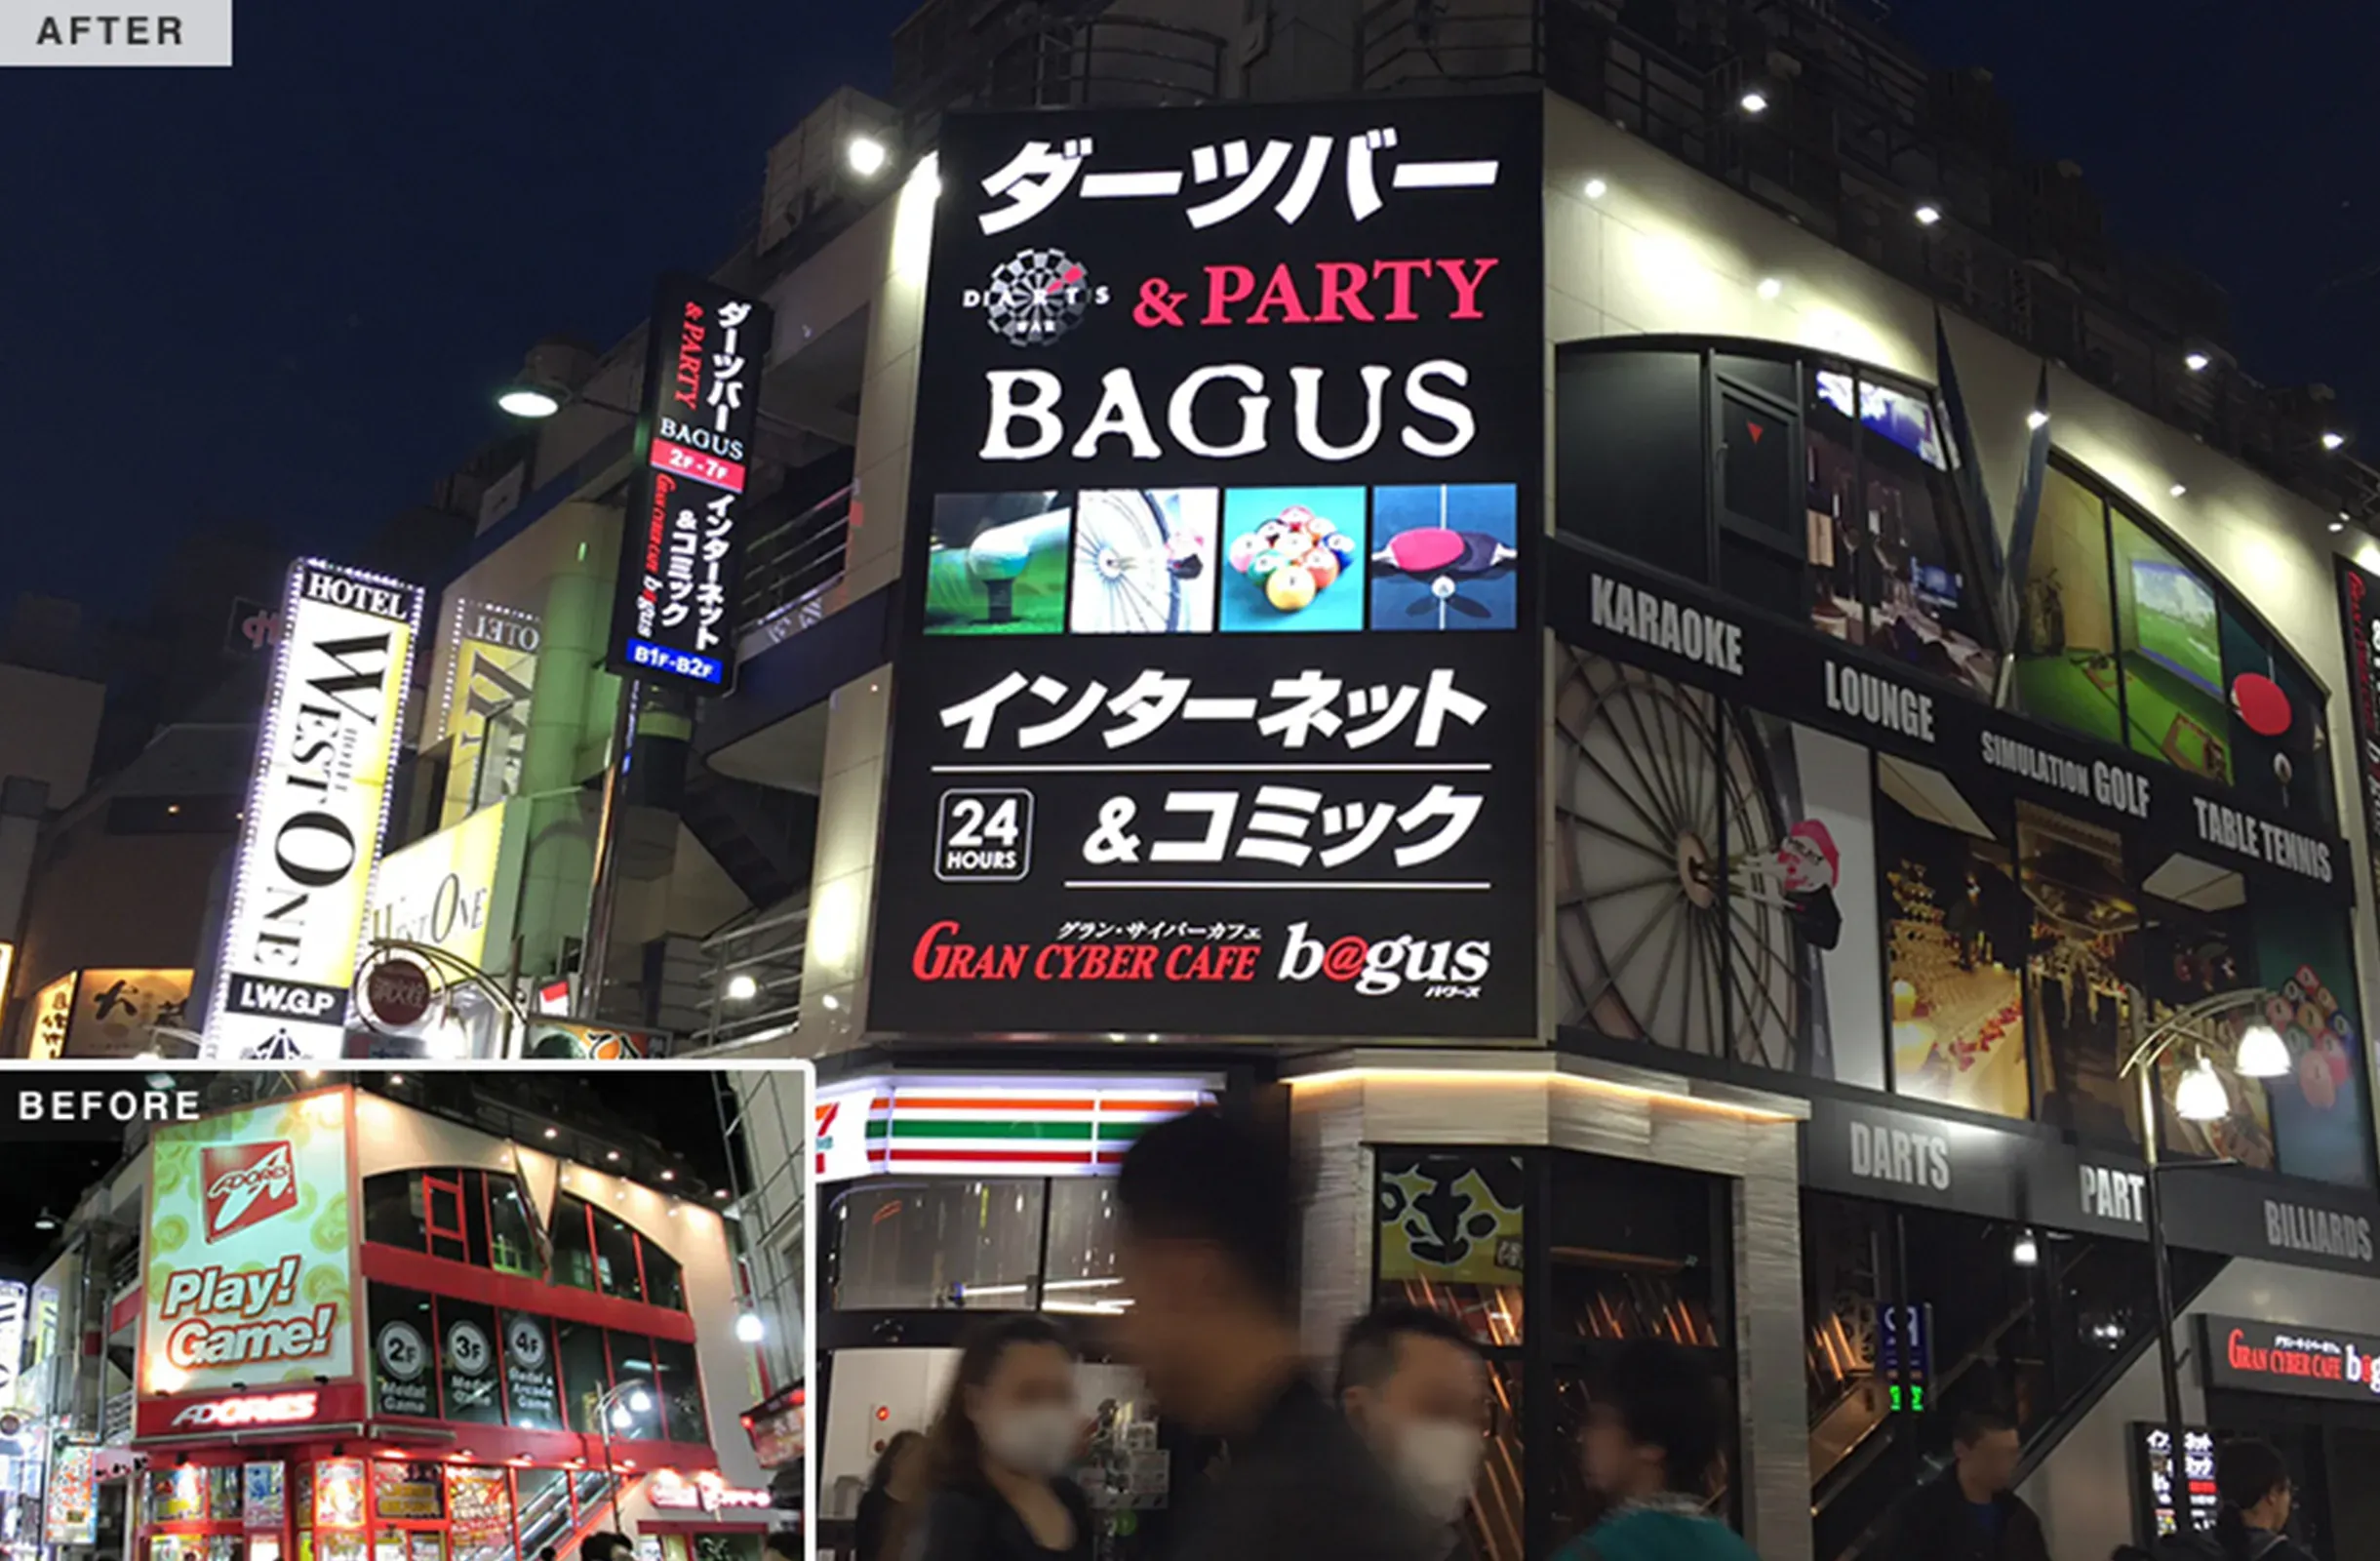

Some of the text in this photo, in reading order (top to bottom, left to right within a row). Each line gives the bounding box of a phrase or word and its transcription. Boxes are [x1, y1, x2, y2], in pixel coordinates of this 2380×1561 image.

[978, 128, 1499, 236] ダーツバー
[1131, 259, 1498, 327] & PARTY
[675, 321, 705, 411] PARTY
[706, 301, 752, 432] ダーツバー
[660, 417, 743, 460] BAGUS
[978, 360, 1475, 460] BAGUS
[307, 573, 407, 620] HOTEL
[695, 495, 734, 651] インターネット
[1591, 574, 1744, 676] KARAOKE
[939, 668, 1488, 749] インターネット
[1825, 660, 1935, 743] LOUNGE
[255, 632, 393, 966] WEST ONE
[1981, 730, 2151, 819] SIMULATION GOLF
[948, 798, 1019, 847] 24
[2193, 796, 2332, 883] TABLE TENNIS
[946, 851, 1017, 869] HOURS
[912, 920, 1490, 995] GRAN CYBER CAFE b@gus
[1850, 1123, 1949, 1189] DARTS
[2080, 1165, 2145, 1222] PART
[2264, 1200, 2373, 1261] BILLIARDS
[161, 1255, 300, 1319] Play!
[167, 1303, 337, 1371] Game!
[389, 1338, 416, 1363] 2F
[456, 1336, 481, 1358] 3F
[516, 1332, 538, 1352] 4F
